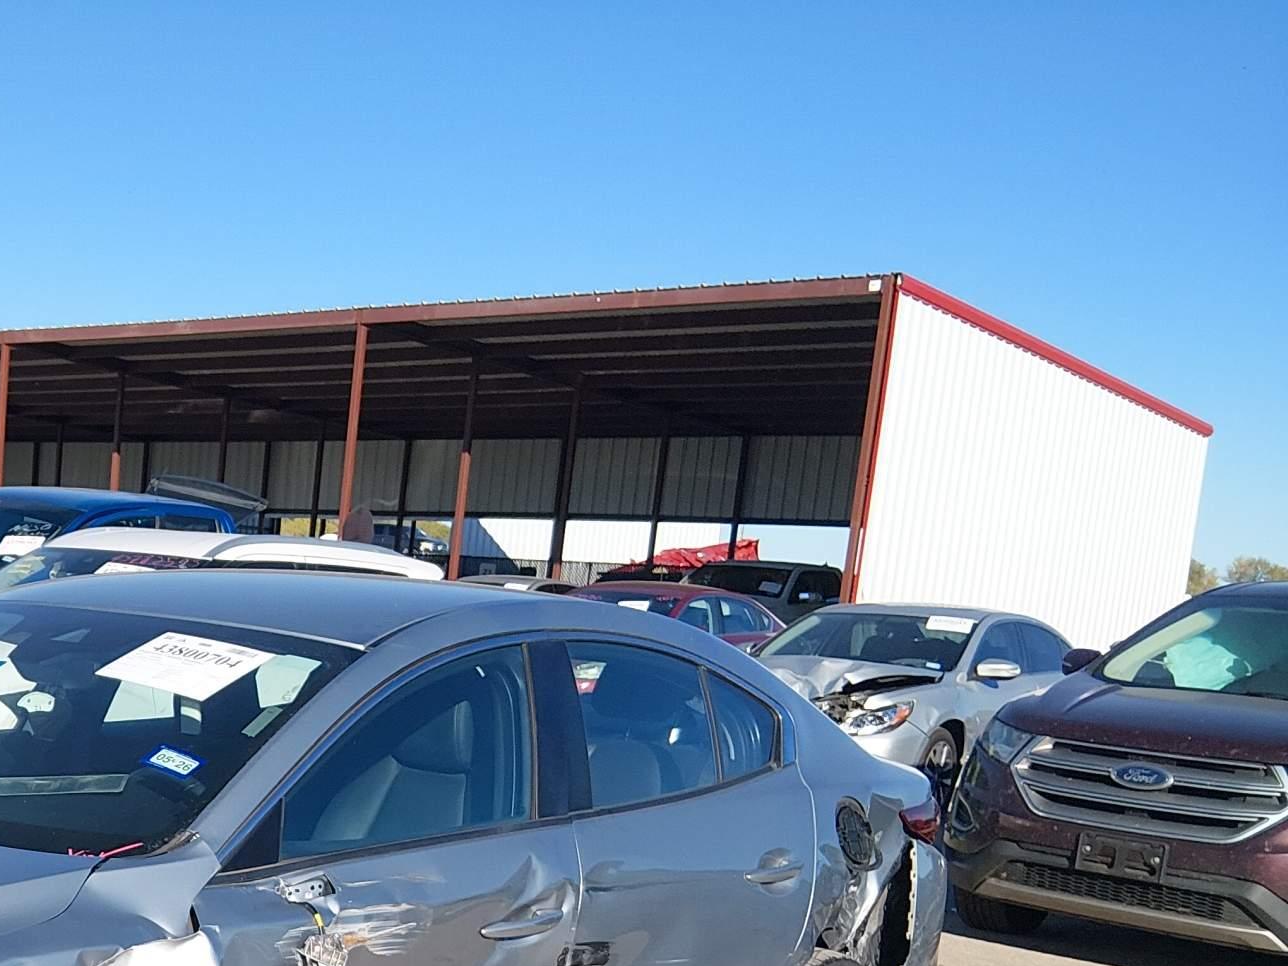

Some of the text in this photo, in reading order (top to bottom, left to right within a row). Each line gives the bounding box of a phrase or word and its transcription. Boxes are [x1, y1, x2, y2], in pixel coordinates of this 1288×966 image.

[153, 643, 243, 668] 43800704
[156, 753, 193, 772] 05 26
[1123, 768, 1158, 784] Ford
